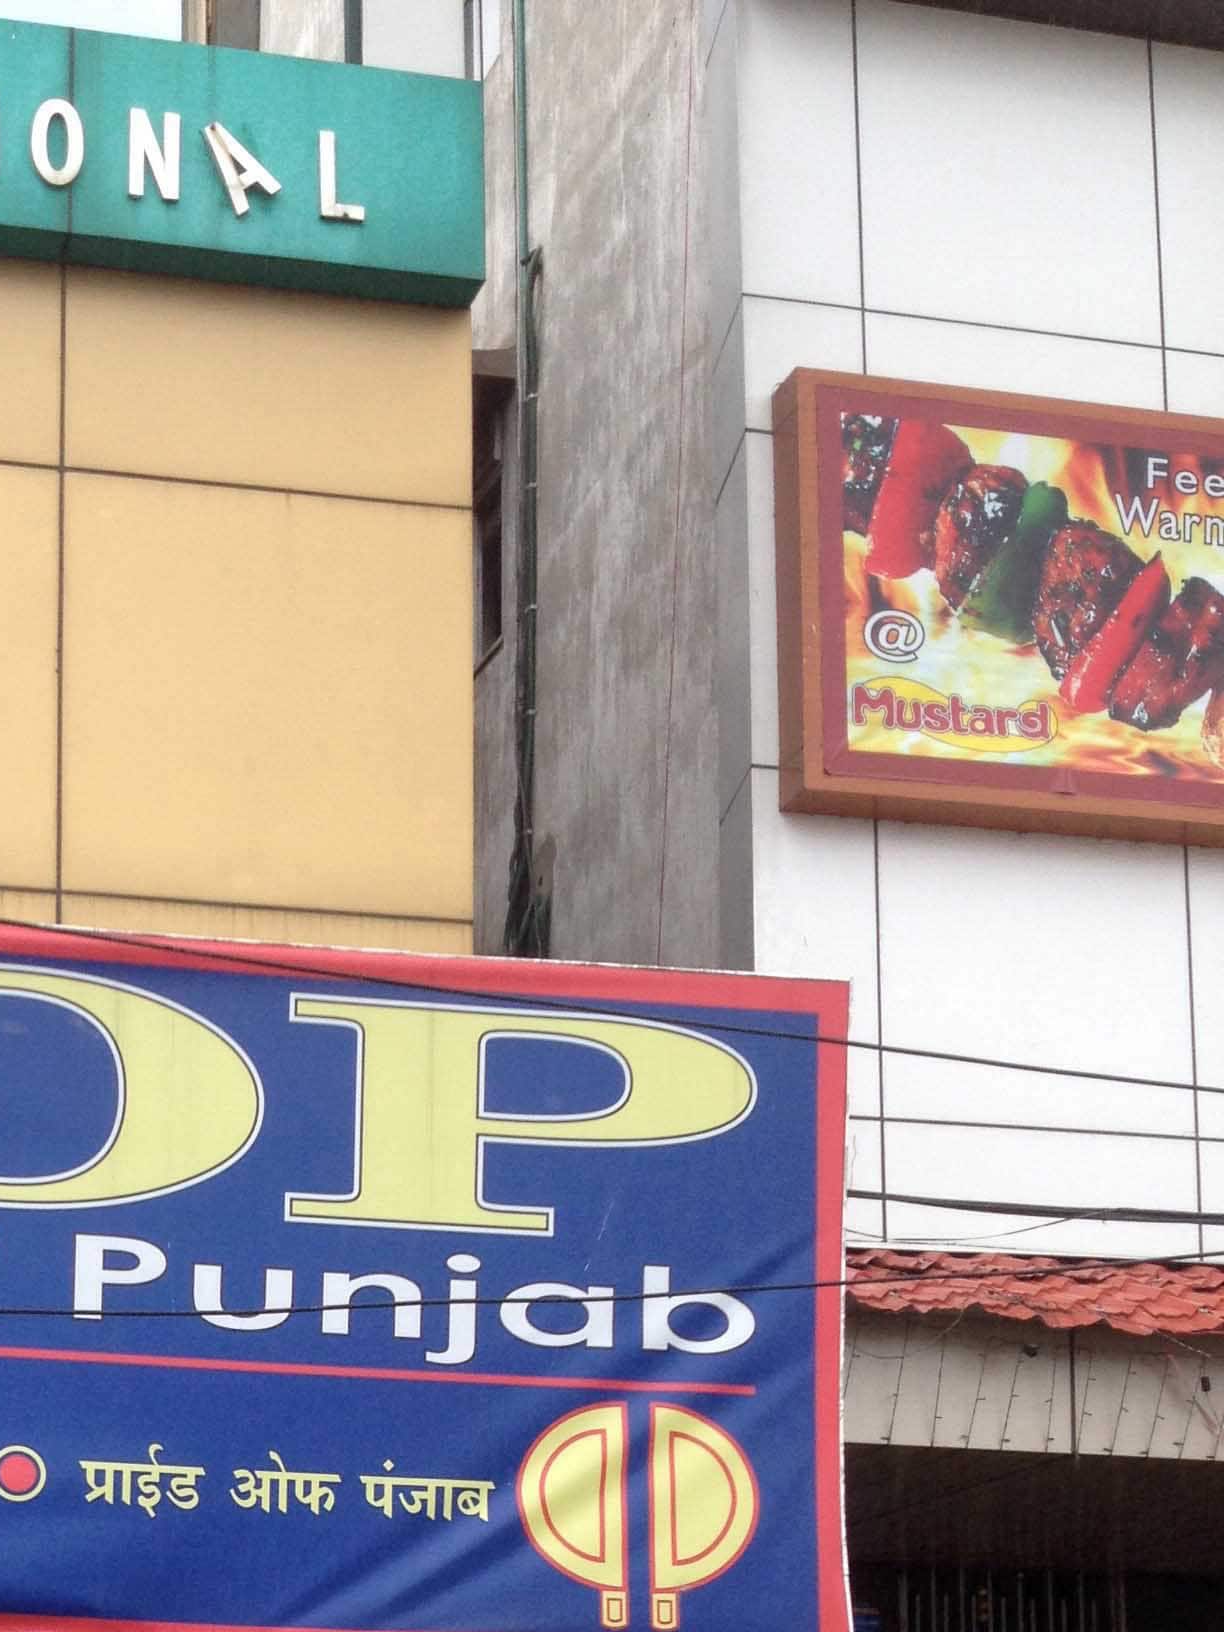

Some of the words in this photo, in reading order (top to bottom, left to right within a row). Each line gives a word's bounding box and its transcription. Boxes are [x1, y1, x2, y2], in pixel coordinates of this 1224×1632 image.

[851, 686, 1054, 742] Mustard
[72, 1233, 757, 1367] Punjab
[78, 1444, 207, 1519] प्राईड
[229, 1451, 342, 1516] ओफ
[359, 1458, 496, 1523] पंजाब
